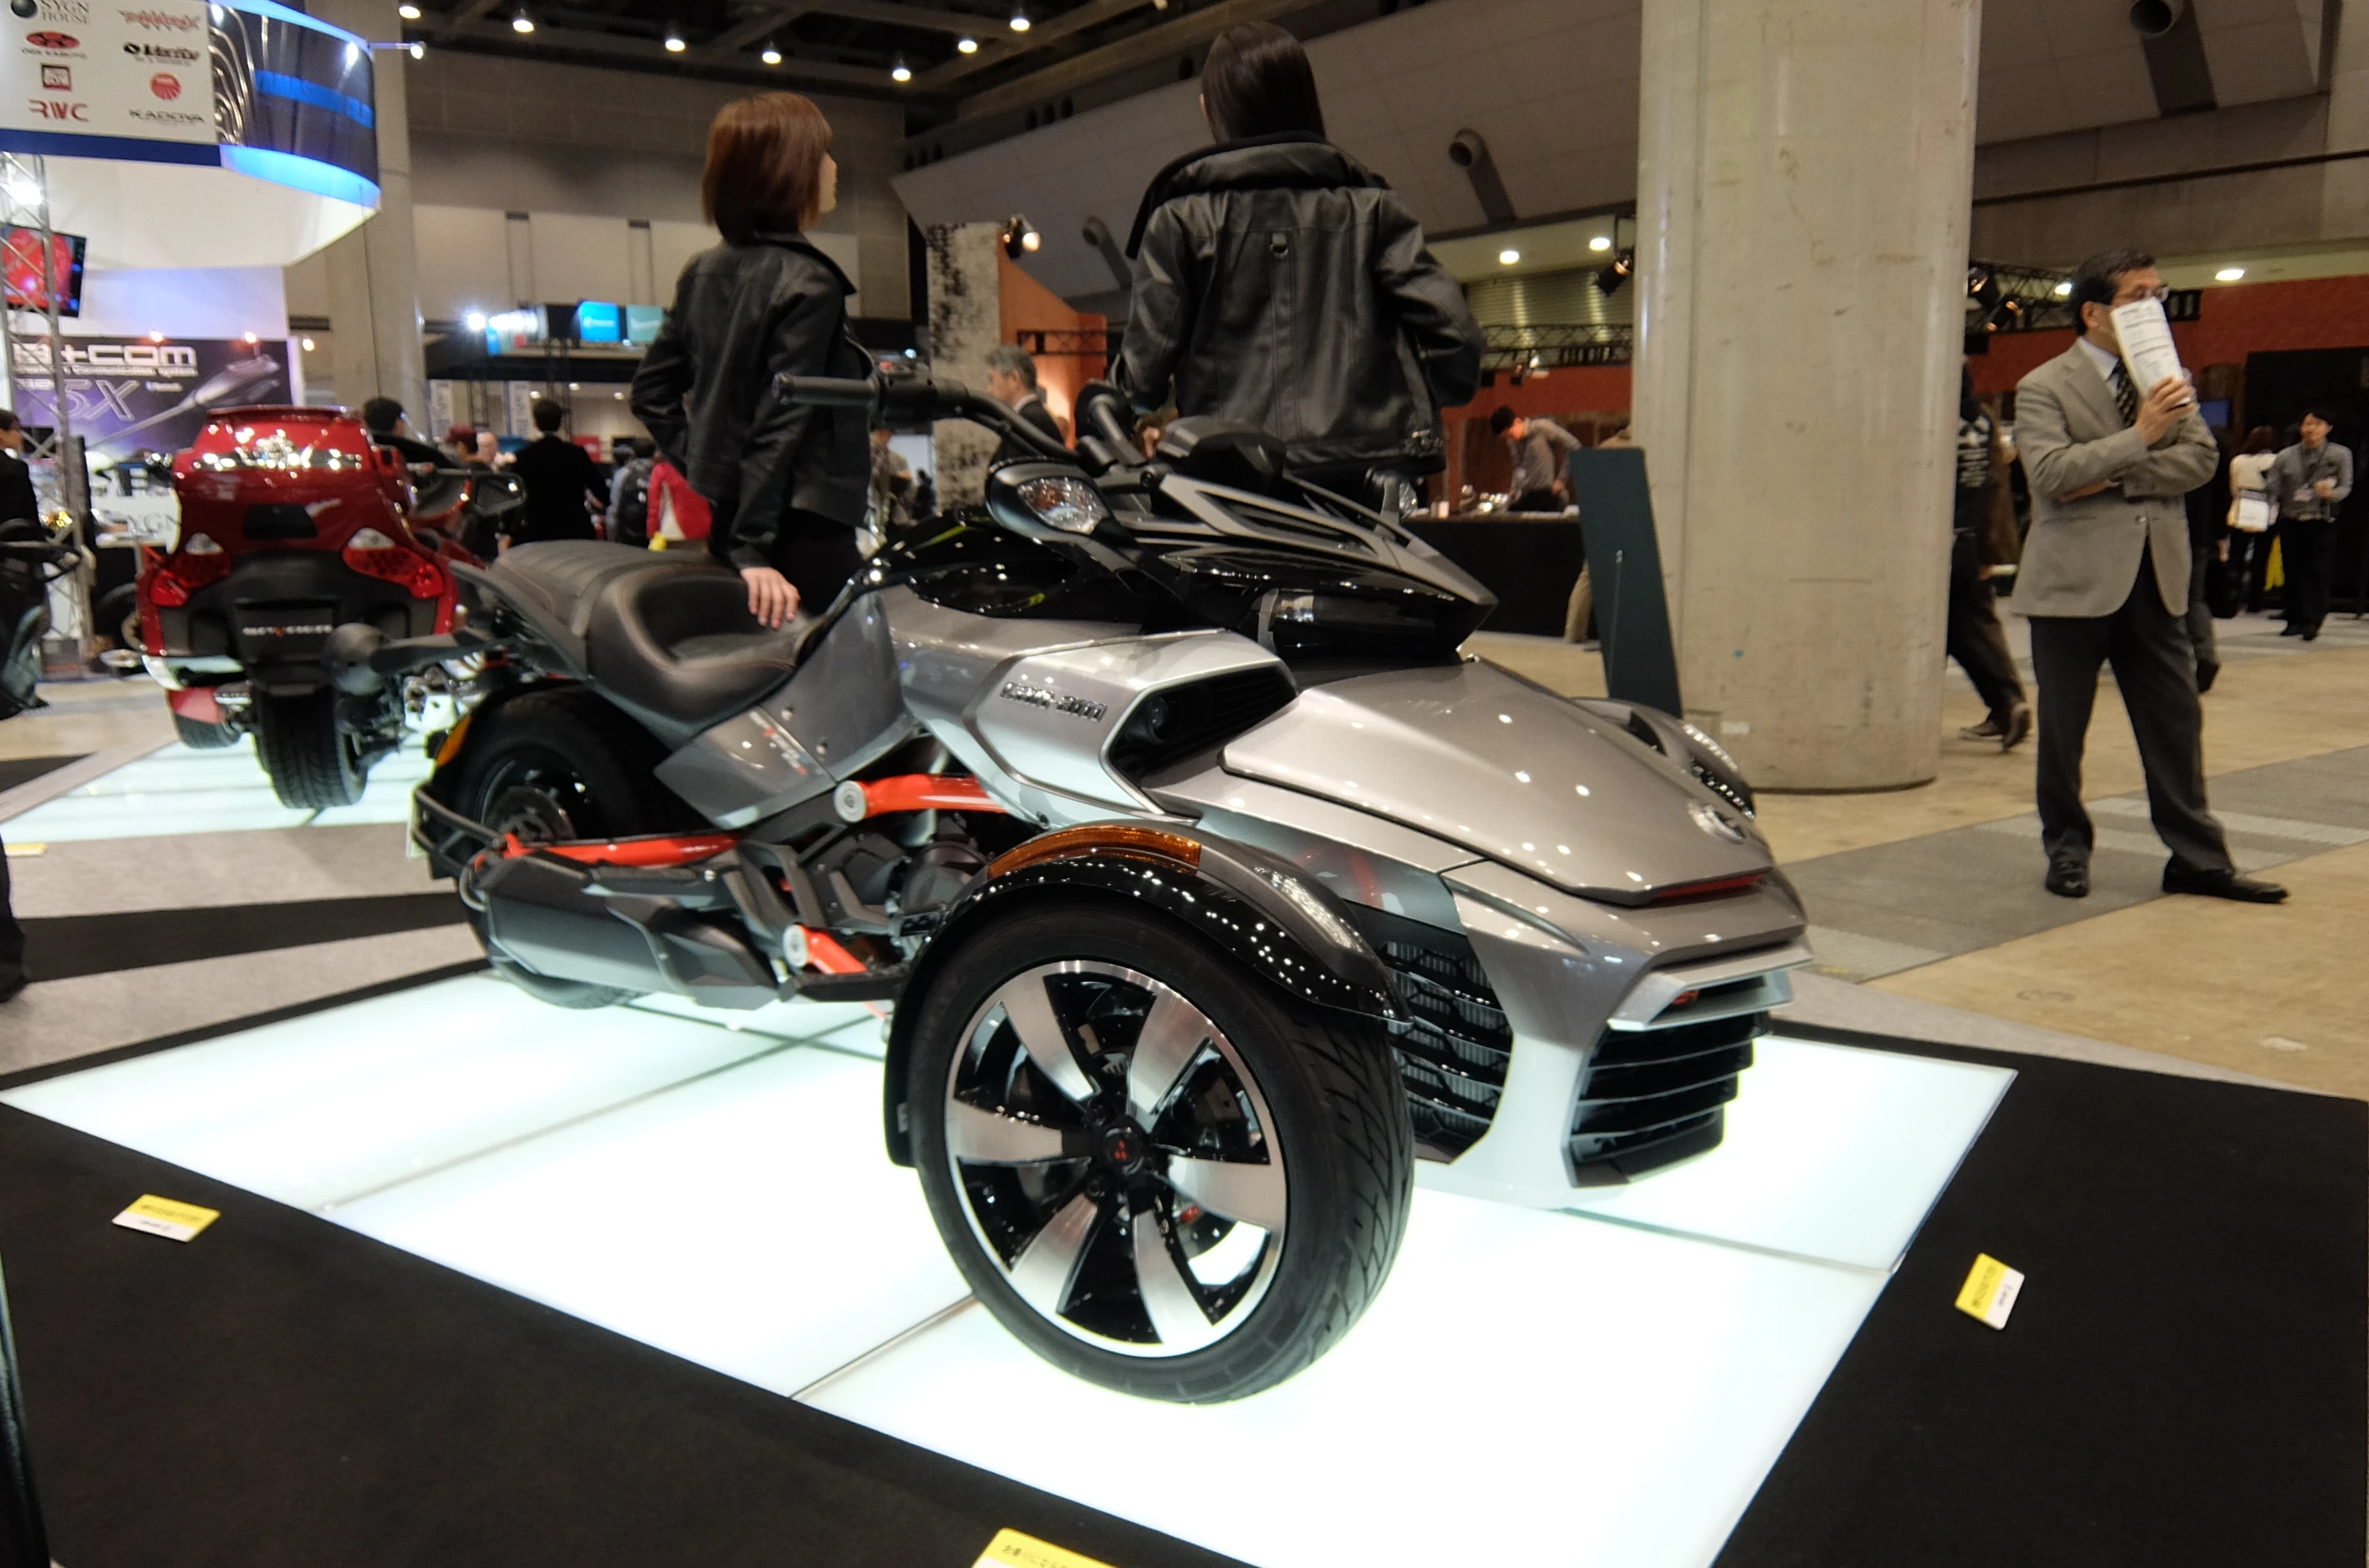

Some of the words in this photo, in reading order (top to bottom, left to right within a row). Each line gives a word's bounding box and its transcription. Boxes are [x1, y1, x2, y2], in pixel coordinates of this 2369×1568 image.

[40, 0, 89, 14] SYGN
[41, 11, 89, 24] HOUSE
[29, 98, 89, 123] RWC
